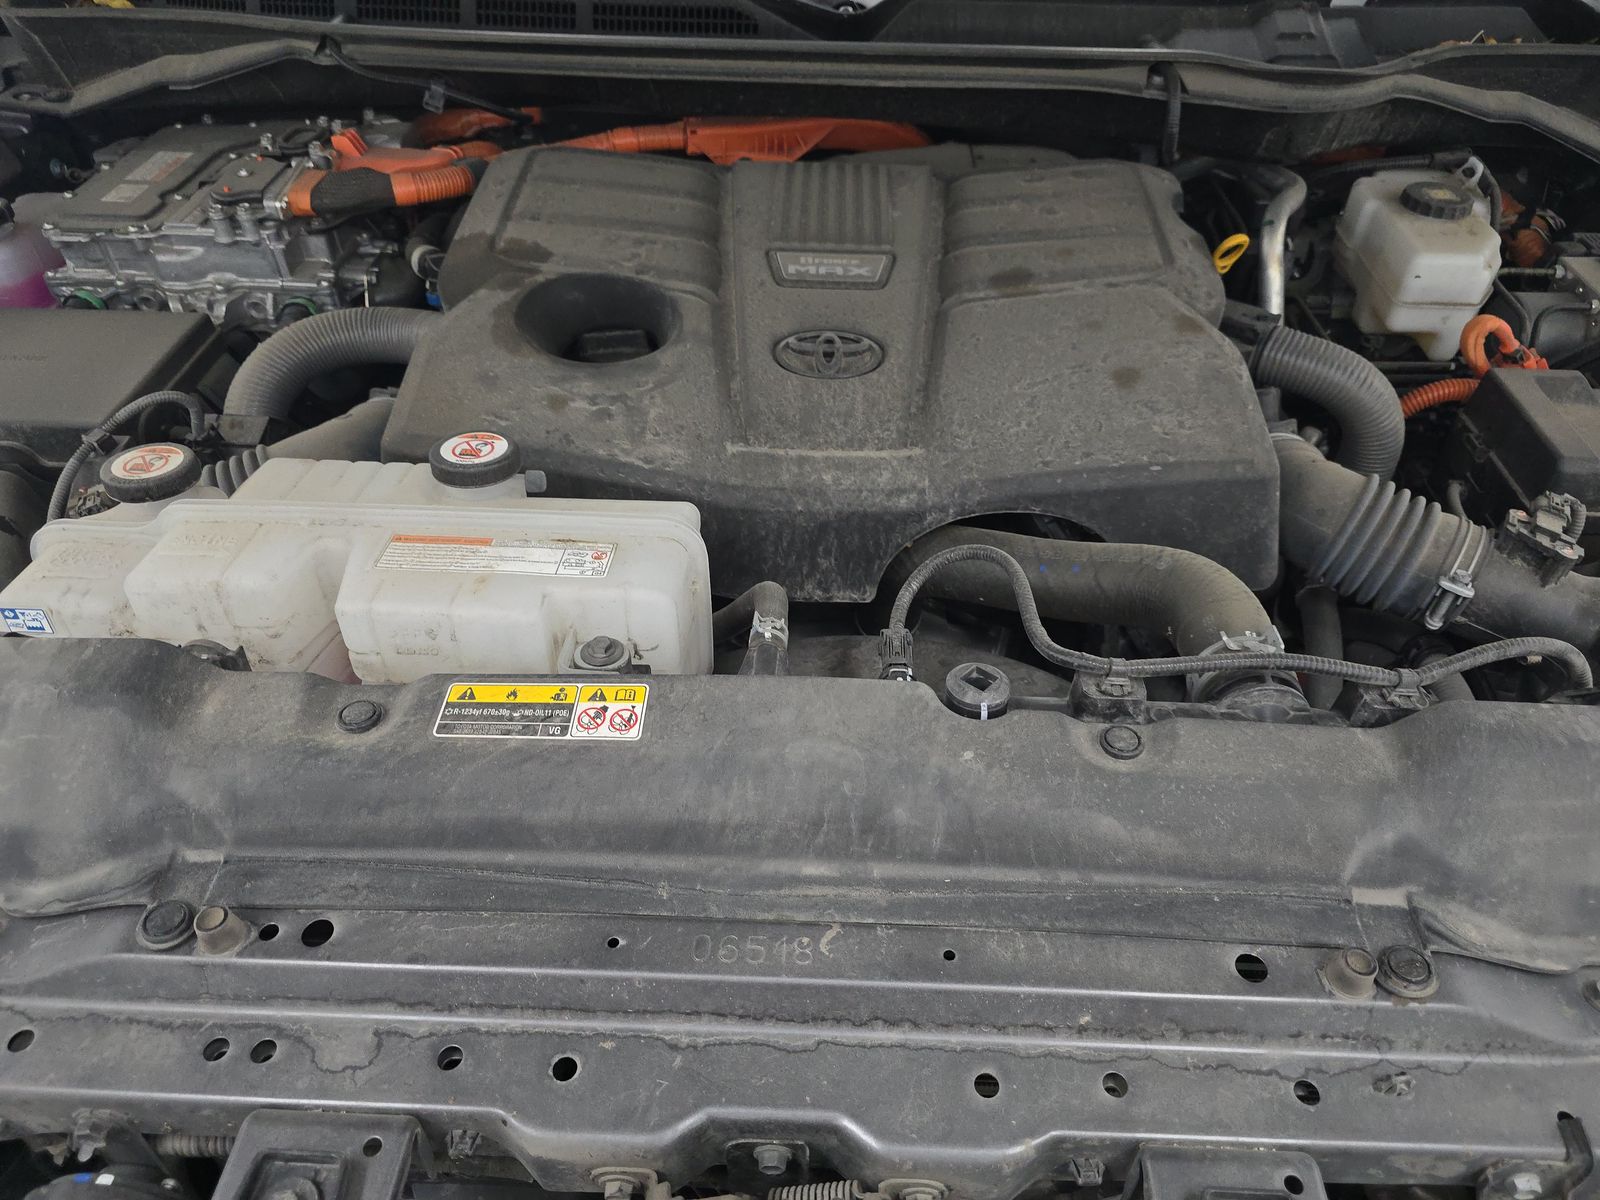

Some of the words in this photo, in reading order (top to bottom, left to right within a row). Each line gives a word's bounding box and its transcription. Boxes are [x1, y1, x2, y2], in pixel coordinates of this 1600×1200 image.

[787, 263, 873, 277] MAX
[552, 709, 570, 718] (POE)
[548, 726, 561, 735] VG
